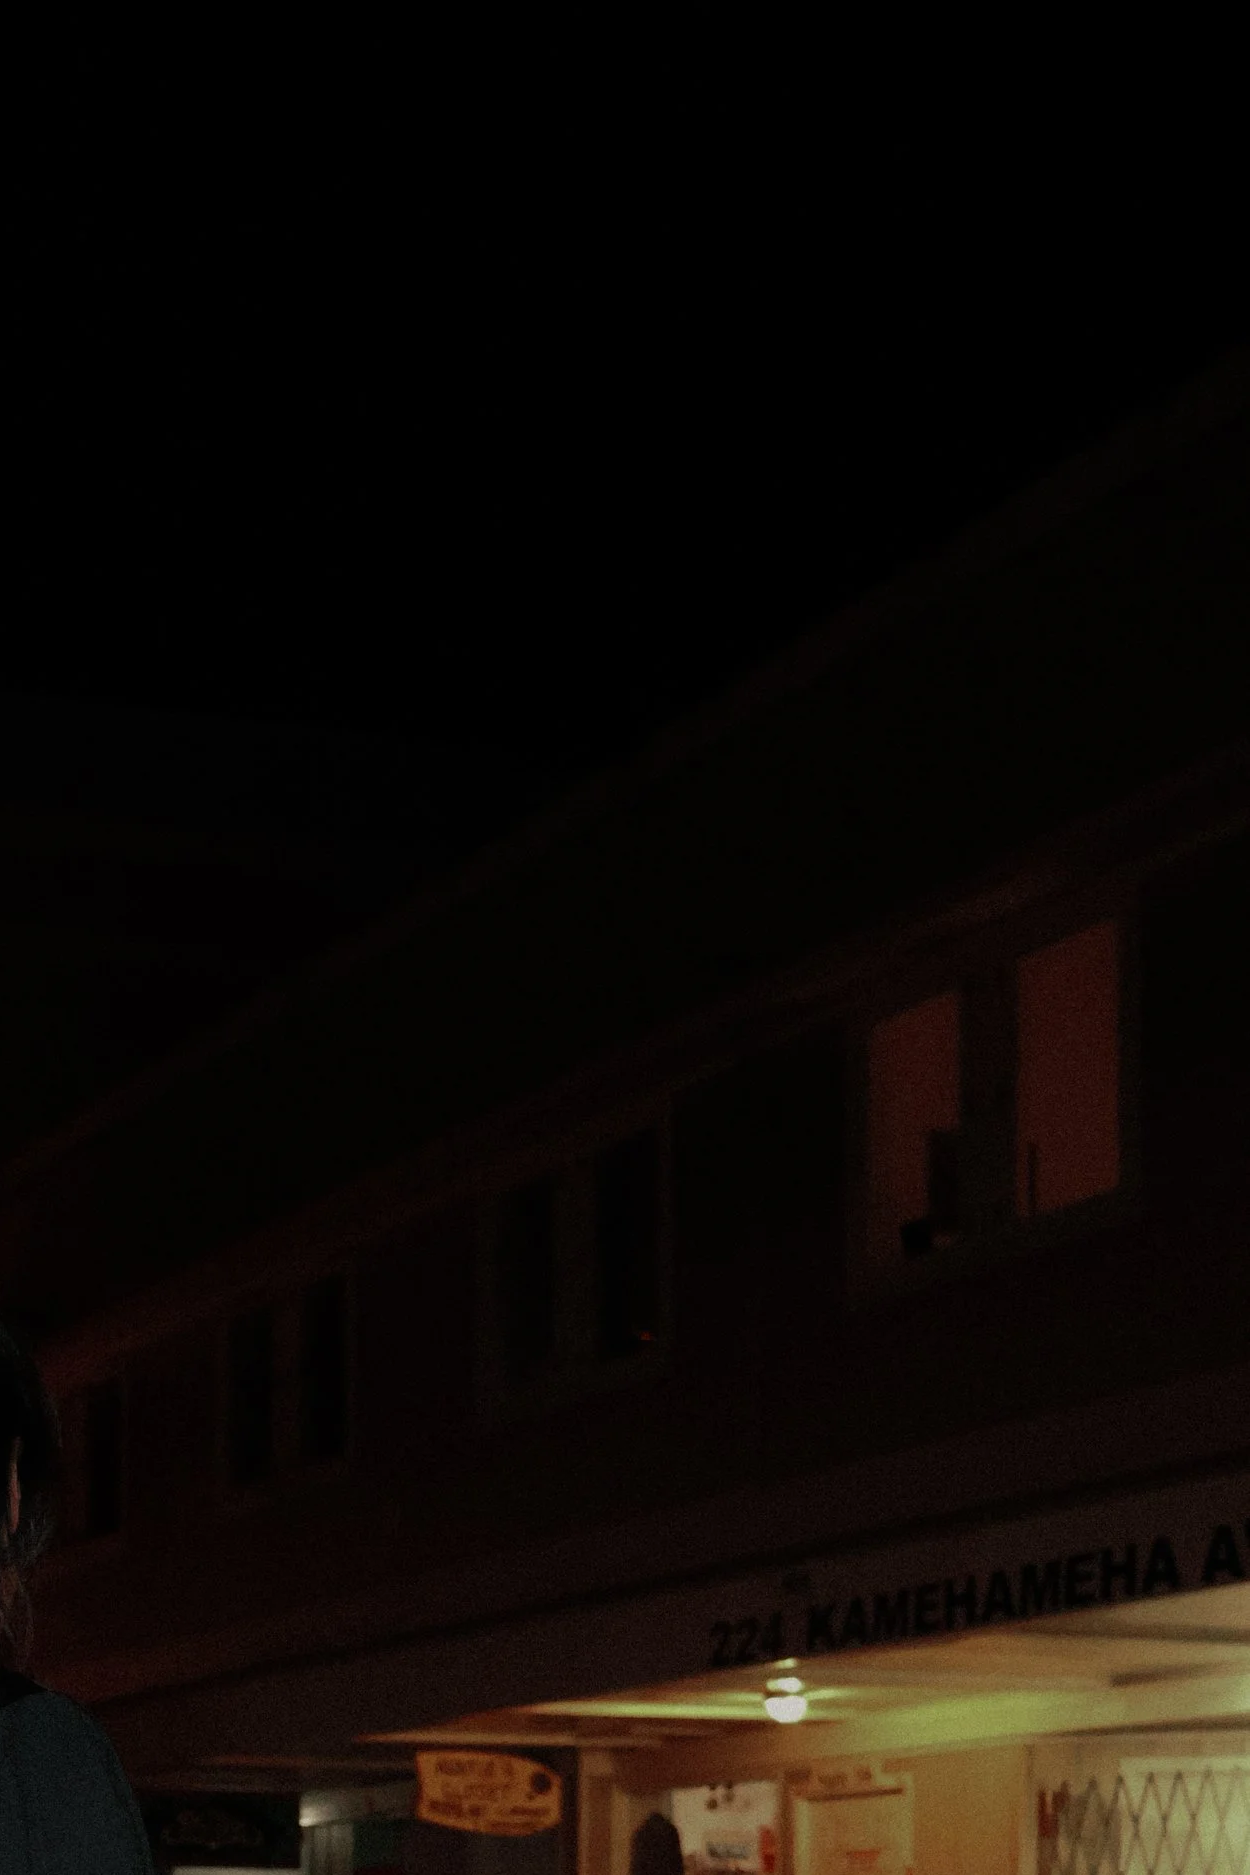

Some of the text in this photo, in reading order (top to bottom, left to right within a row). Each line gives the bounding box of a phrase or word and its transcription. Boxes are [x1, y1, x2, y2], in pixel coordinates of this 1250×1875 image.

[711, 1517, 1250, 1668] 224 KAMEHAMEHA A
